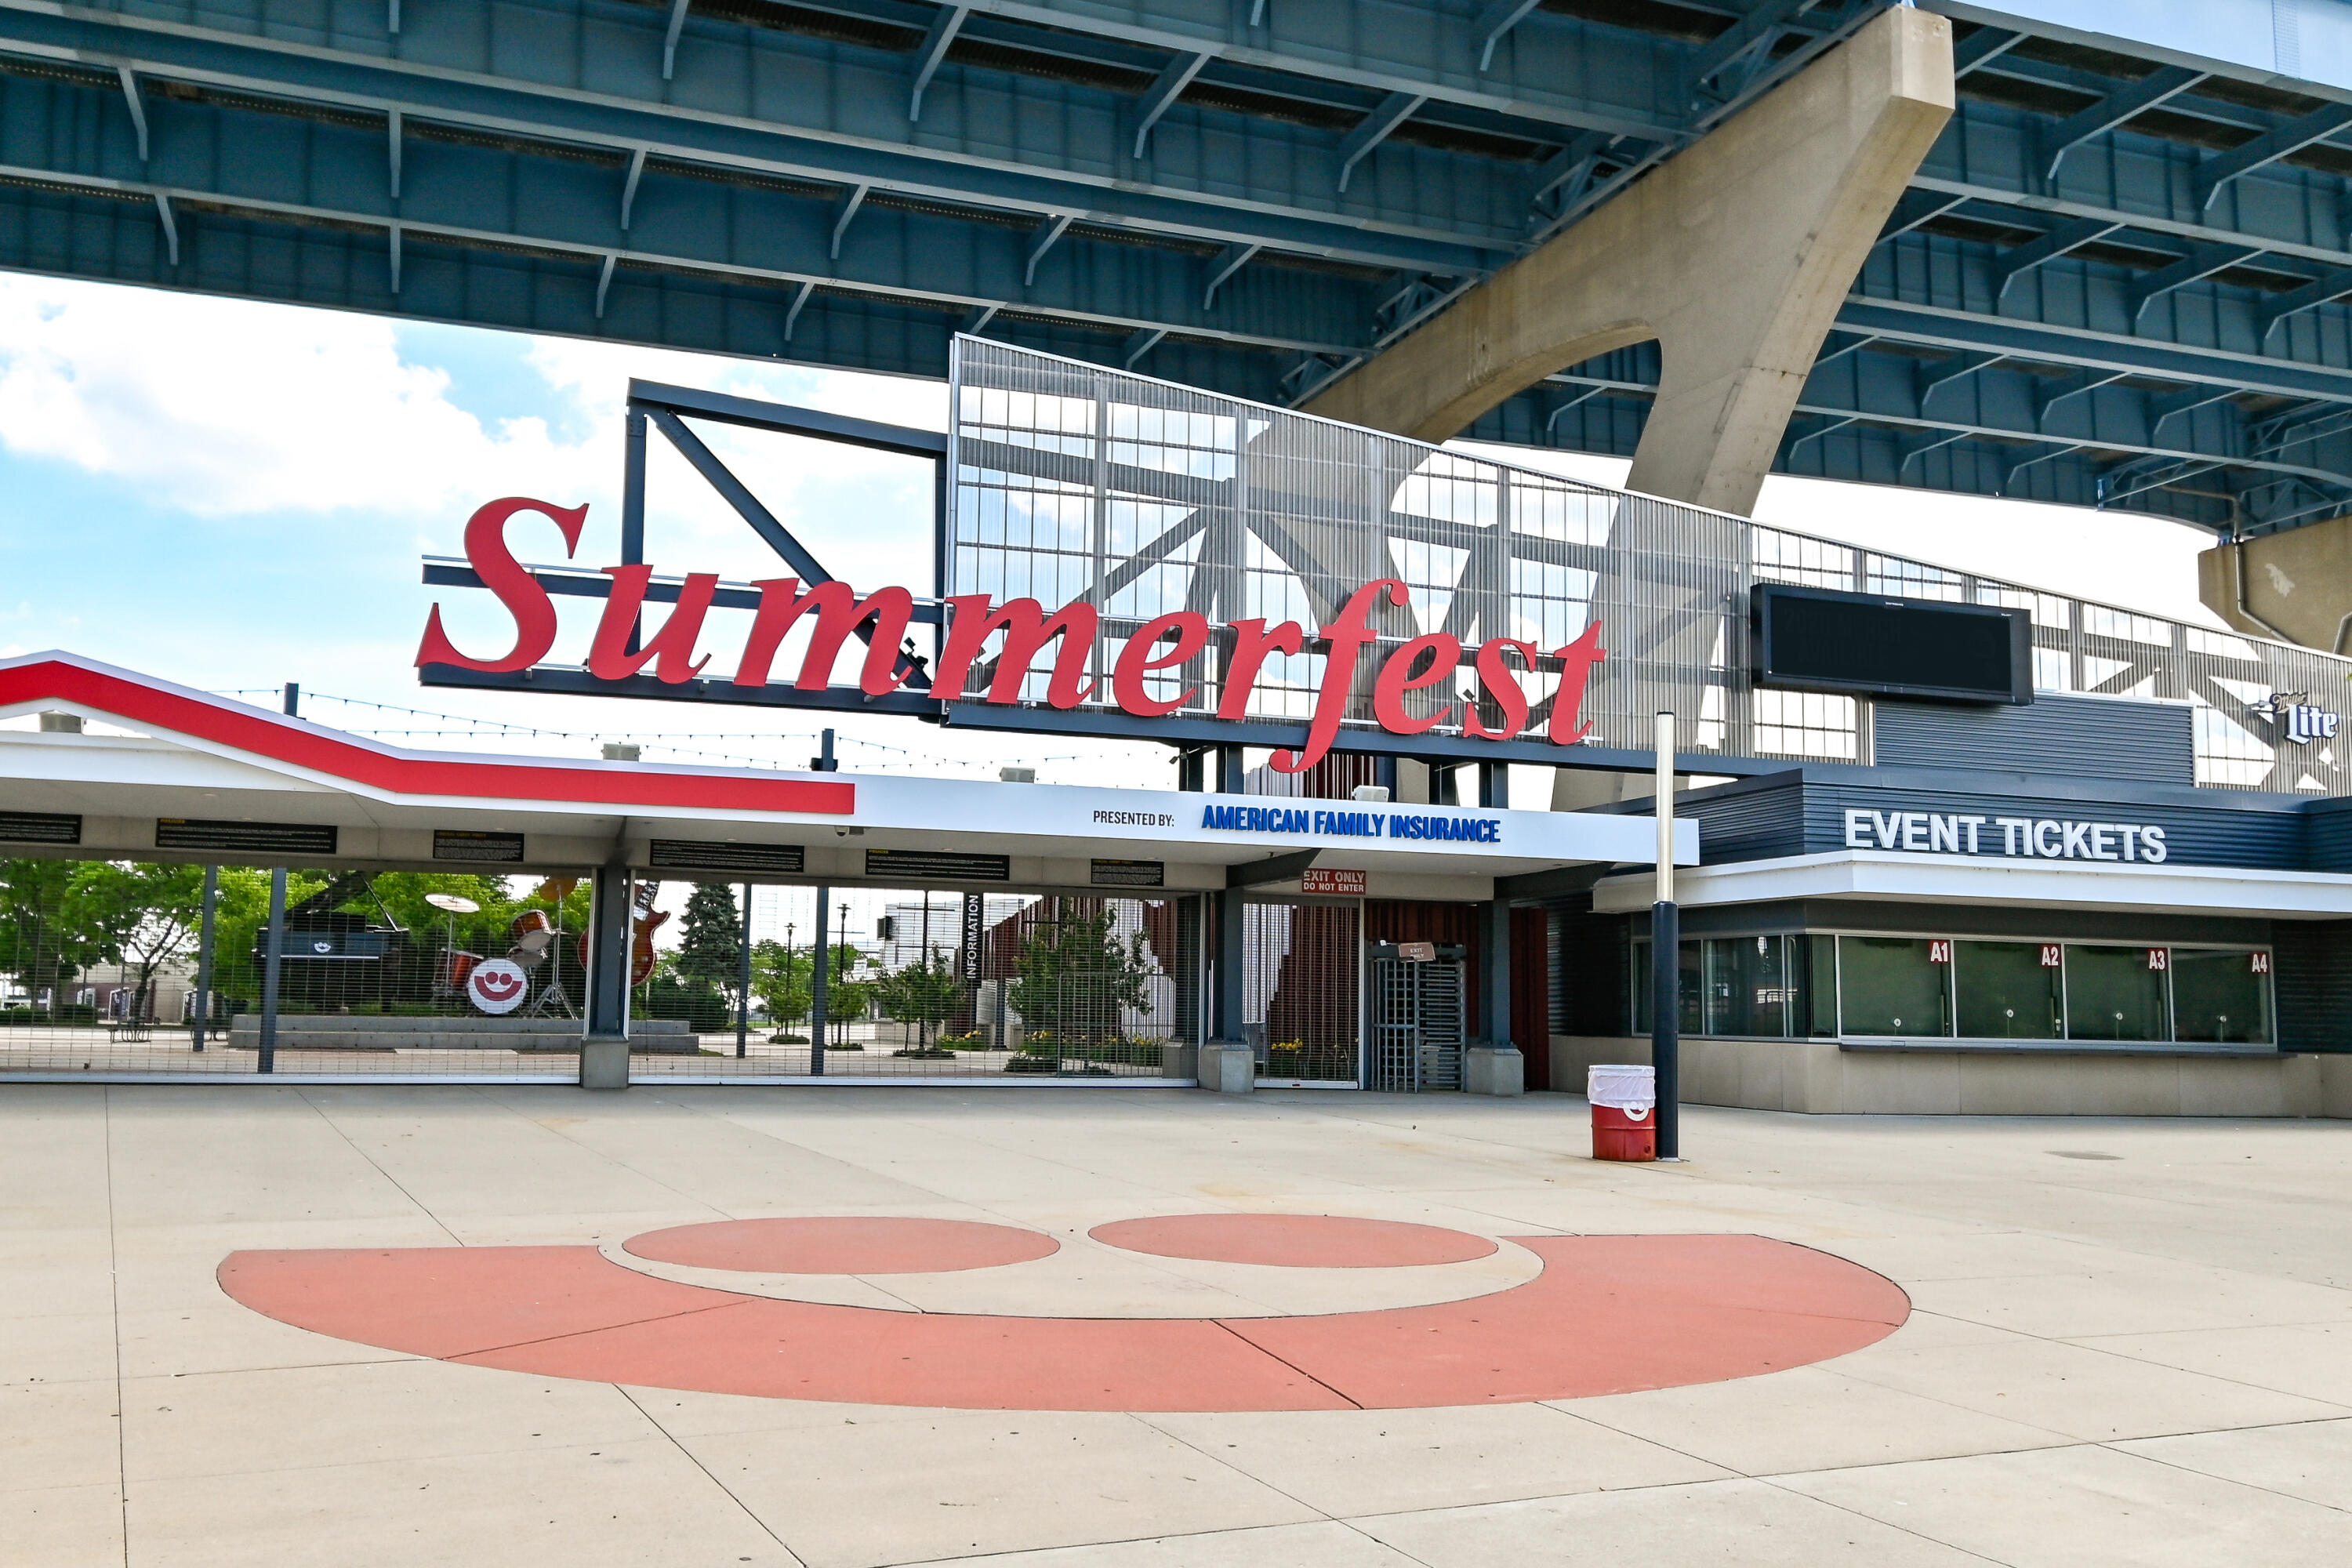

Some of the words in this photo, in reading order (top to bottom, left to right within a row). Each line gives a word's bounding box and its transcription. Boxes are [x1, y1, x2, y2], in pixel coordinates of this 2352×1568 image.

[414, 496, 1607, 773] Summerfest
[2270, 693, 2307, 713] Miller
[2285, 704, 2339, 744] Lite
[1093, 810, 1156, 826] PRESENTED
[1158, 814, 1175, 828] BY:
[1201, 804, 1308, 833] AMERICAN
[1314, 811, 1386, 837] FAMILY
[1389, 815, 1501, 843] INSURANCE
[1845, 809, 1987, 854] EVENT
[1995, 818, 2169, 863] TICKETS
[1303, 870, 1330, 882] EXIT
[1334, 871, 1365, 884] ONLY
[1303, 882, 1316, 891] DO
[1319, 883, 1335, 891] NOT
[1338, 884, 1364, 892] ENTER
[966, 895, 978, 979] INFORMATION
[1929, 942, 1949, 962] A1
[2041, 946, 2059, 967] A2
[2149, 949, 2166, 970] A3
[2252, 953, 2268, 973] A4
